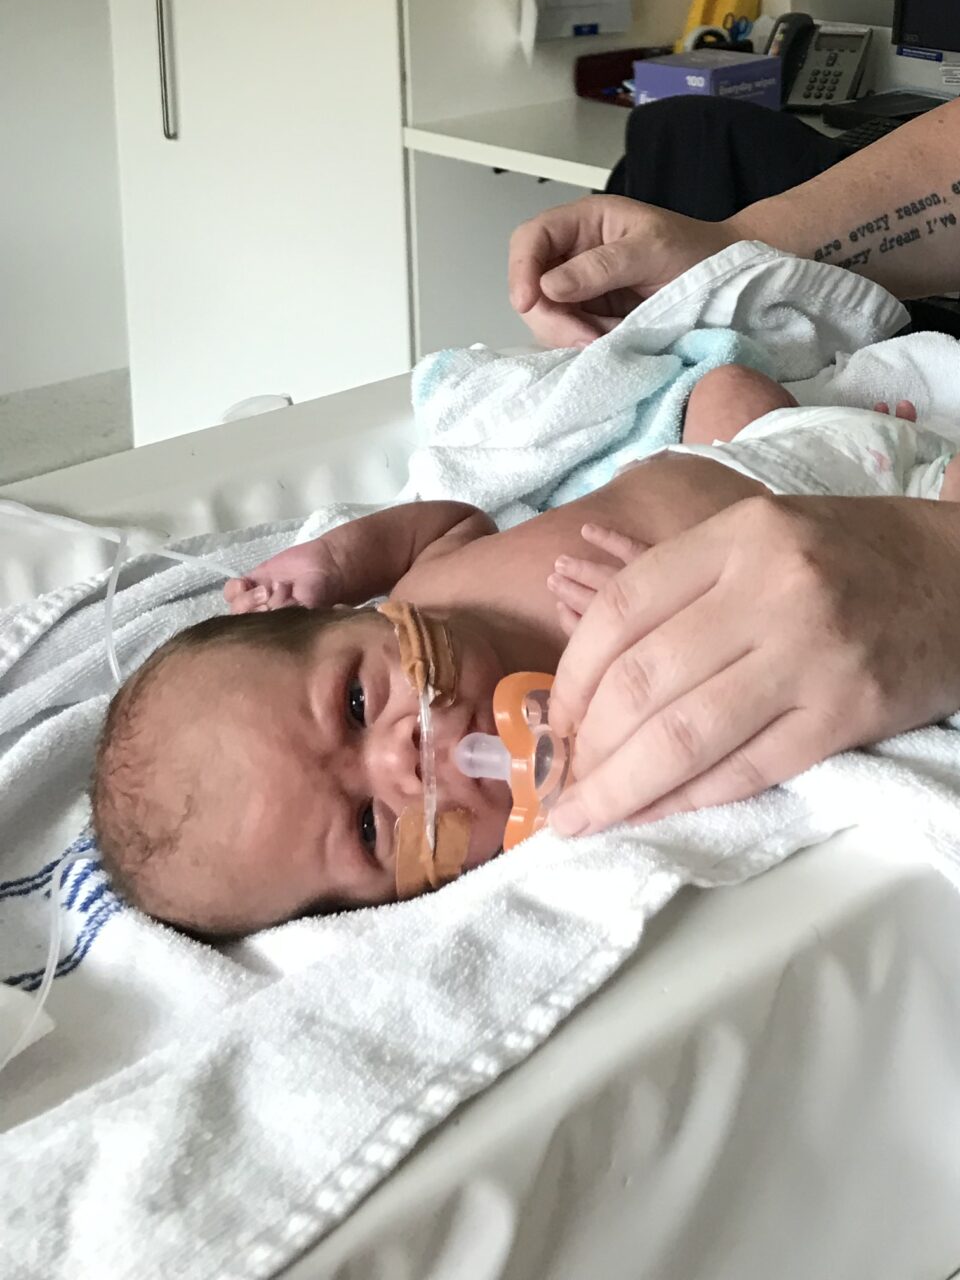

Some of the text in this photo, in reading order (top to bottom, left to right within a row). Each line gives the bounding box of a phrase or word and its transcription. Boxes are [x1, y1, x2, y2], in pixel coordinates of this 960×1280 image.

[686, 75, 704, 88] 100
[814, 239, 842, 261] are
[848, 214, 890, 242] every
[895, 192, 947, 220] reason,
[879, 227, 921, 253] dream
[925, 213, 957, 234] I've
